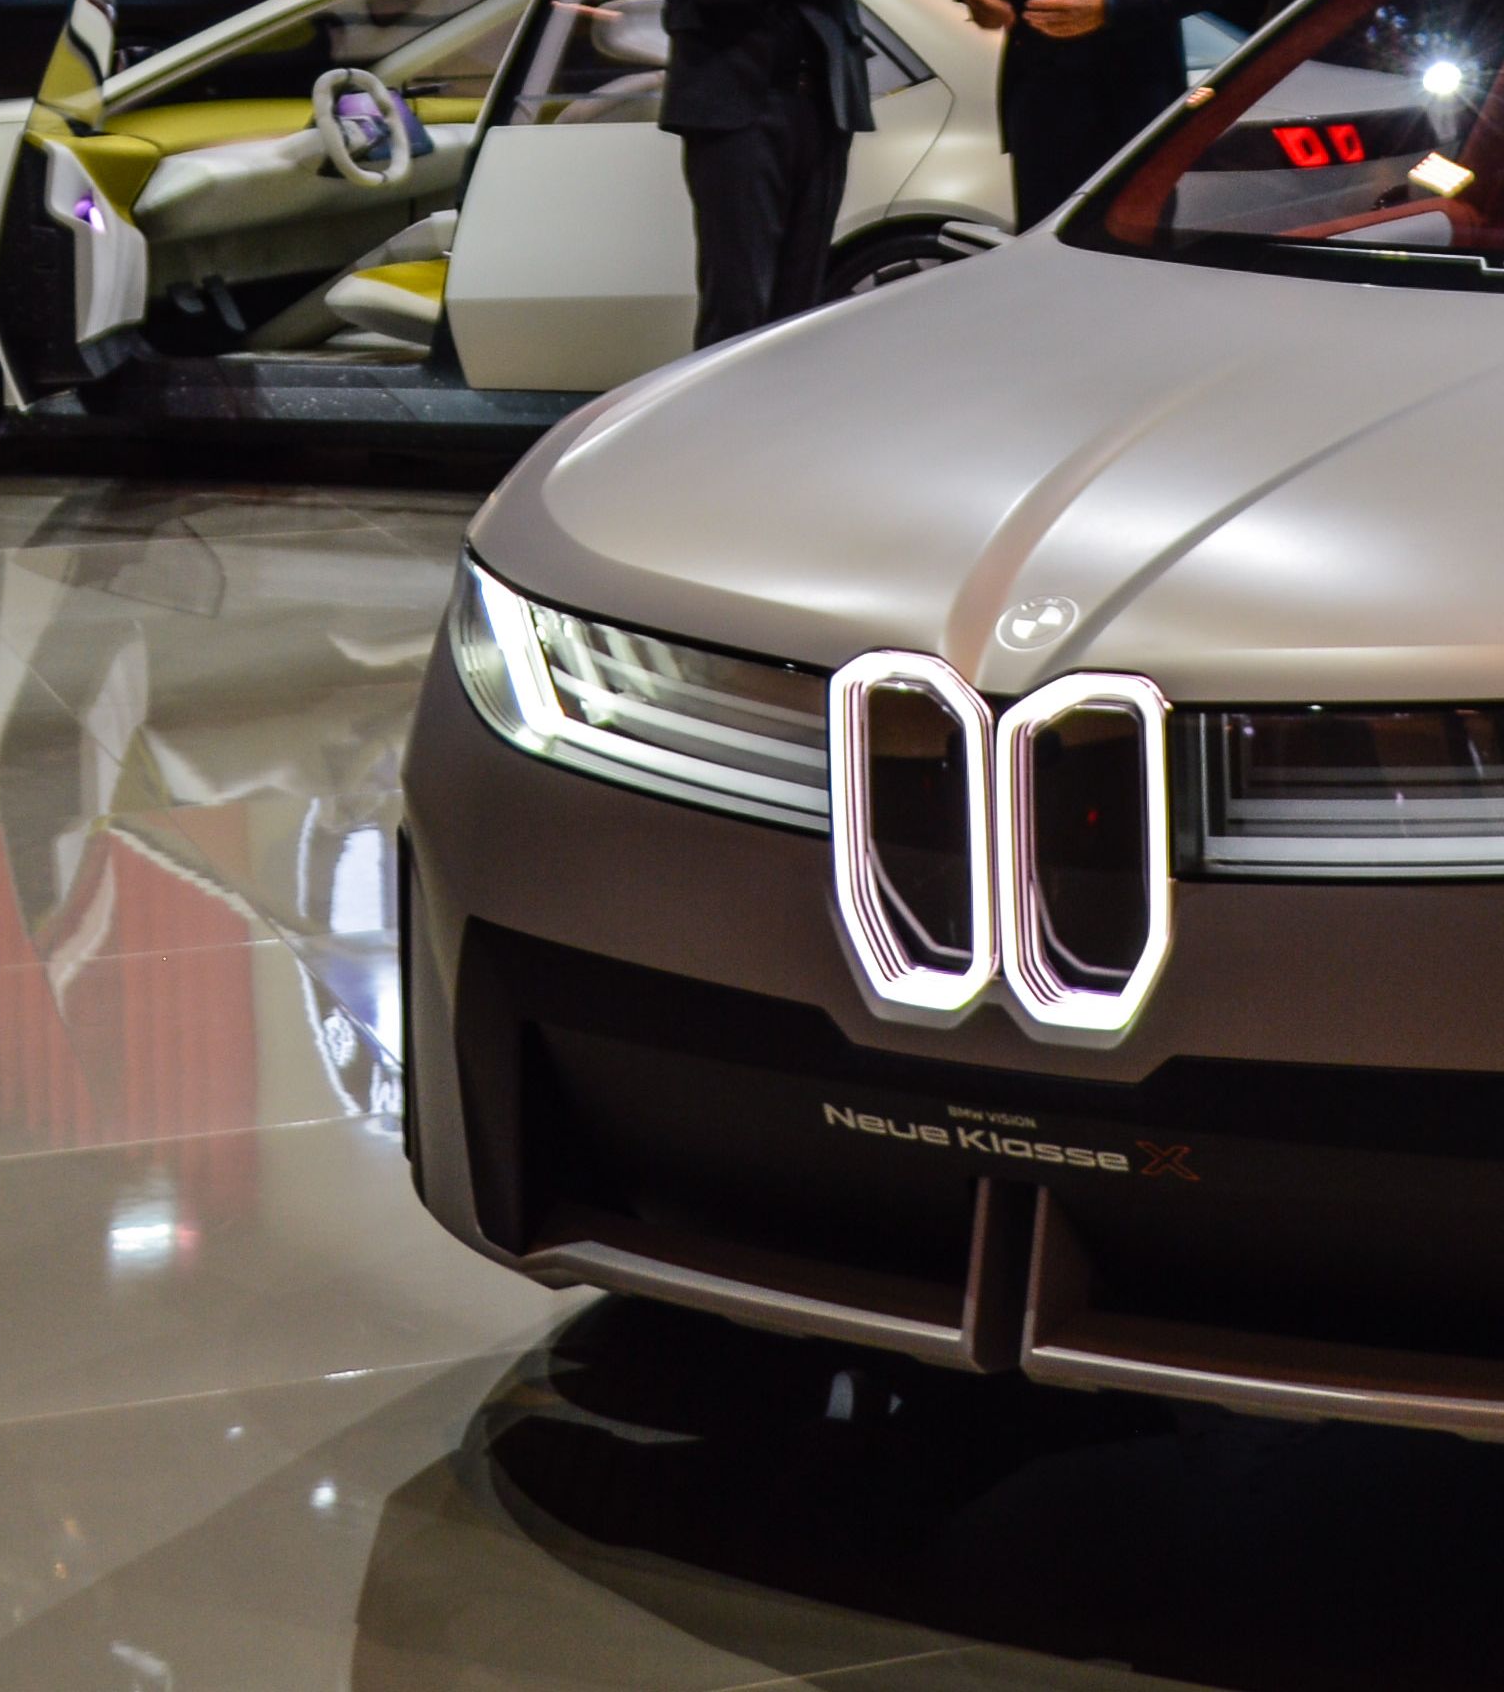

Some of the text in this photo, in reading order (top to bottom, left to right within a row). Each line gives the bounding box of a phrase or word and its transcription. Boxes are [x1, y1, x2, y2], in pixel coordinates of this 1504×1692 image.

[822, 1102, 951, 1145] Neue
[957, 1125, 1130, 1172] Klasse
[947, 1105, 1038, 1128] BMW VISION
